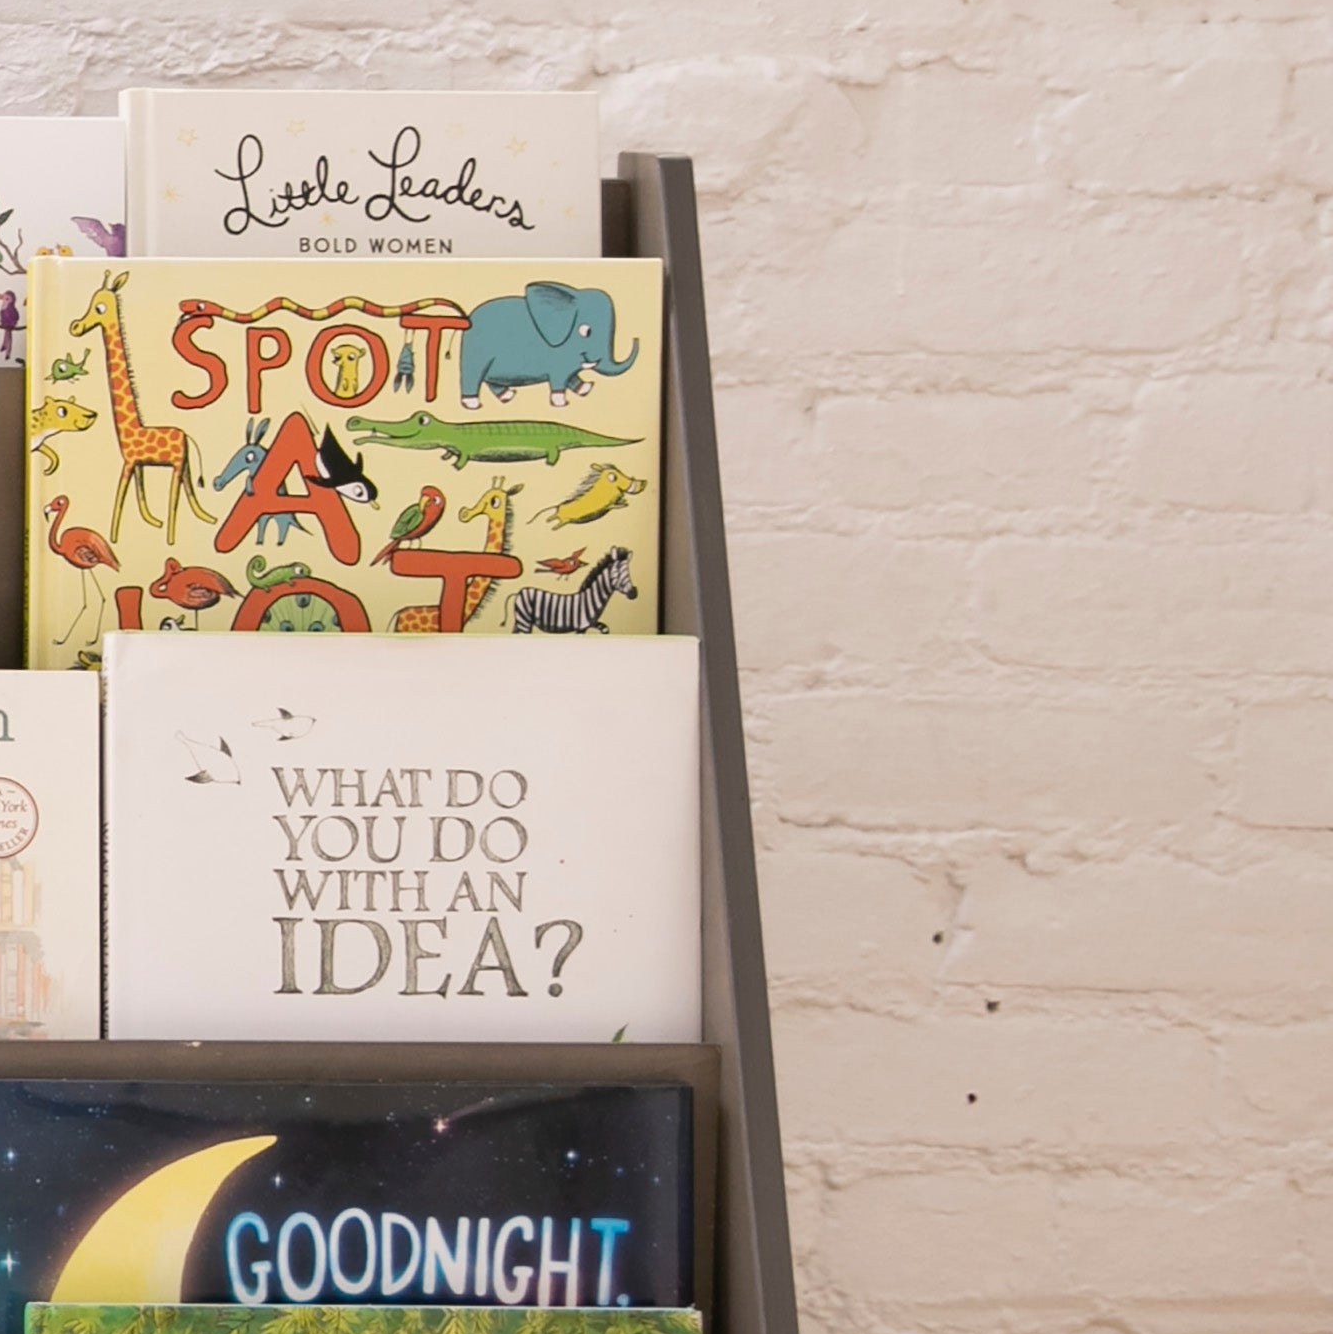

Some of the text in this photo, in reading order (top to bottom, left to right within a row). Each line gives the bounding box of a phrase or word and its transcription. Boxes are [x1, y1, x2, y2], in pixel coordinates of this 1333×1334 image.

[214, 126, 535, 235] Little Leaders
[299, 237, 453, 255] BOLD WOMEN
[171, 314, 471, 413] SPOT
[214, 411, 361, 566] A
[1, 799, 27, 813] York
[272, 767, 527, 809] WHAT DO
[272, 814, 527, 863] YOU DO
[273, 869, 527, 913] WITH AN
[273, 917, 583, 999] IDEA?
